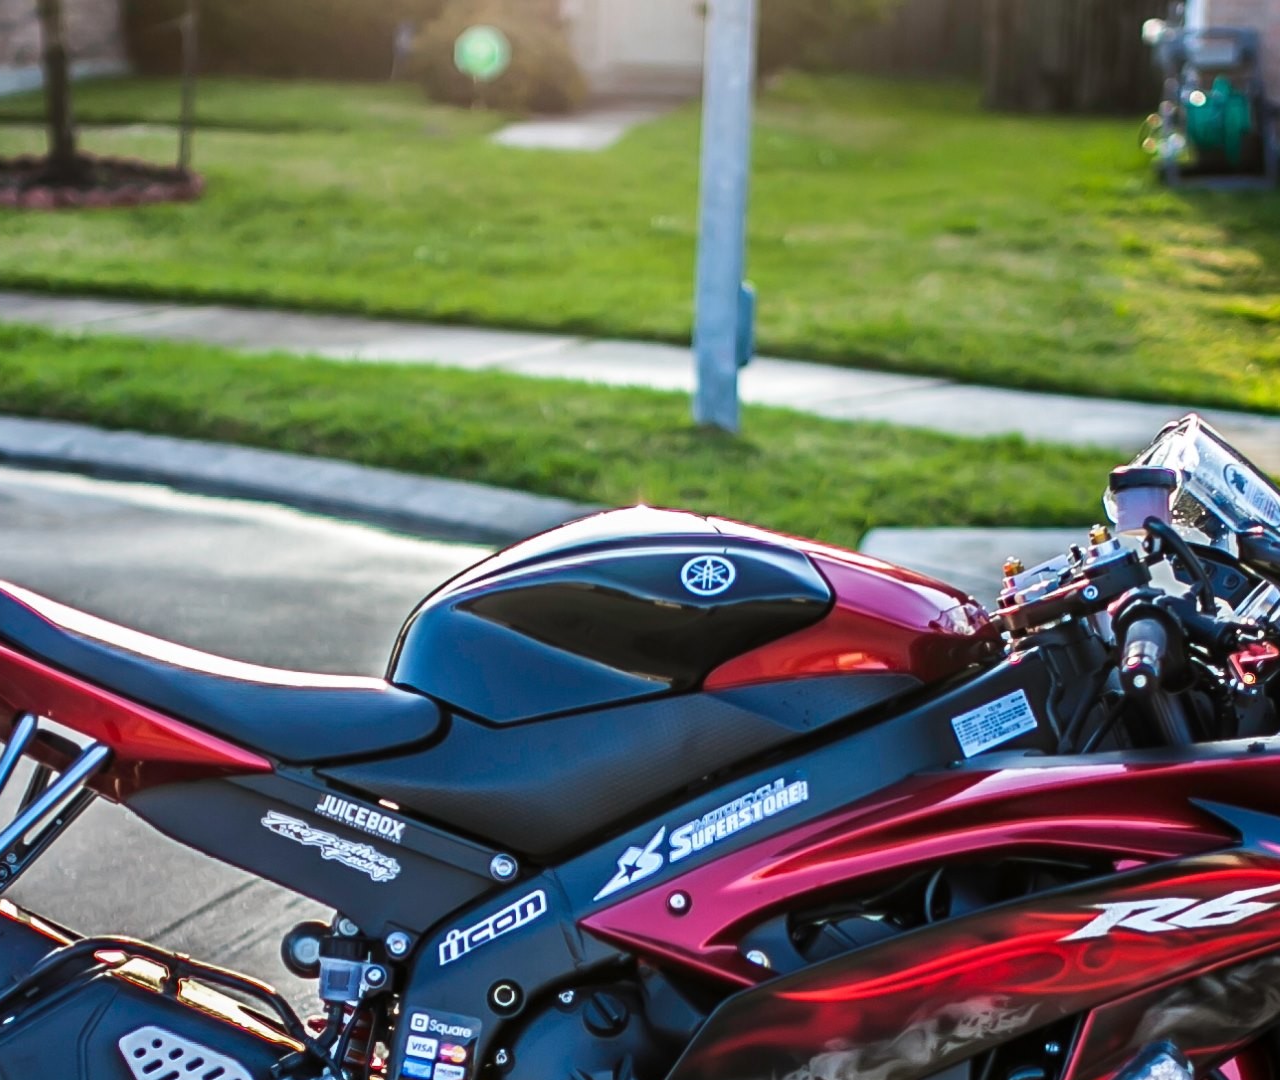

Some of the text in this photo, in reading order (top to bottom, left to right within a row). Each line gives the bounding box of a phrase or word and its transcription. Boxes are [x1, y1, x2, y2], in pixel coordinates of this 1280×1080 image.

[317, 794, 406, 840] JUICEBOX
[440, 890, 546, 965] icon
[428, 1018, 473, 1038] Square
[411, 1041, 434, 1054] VISA
